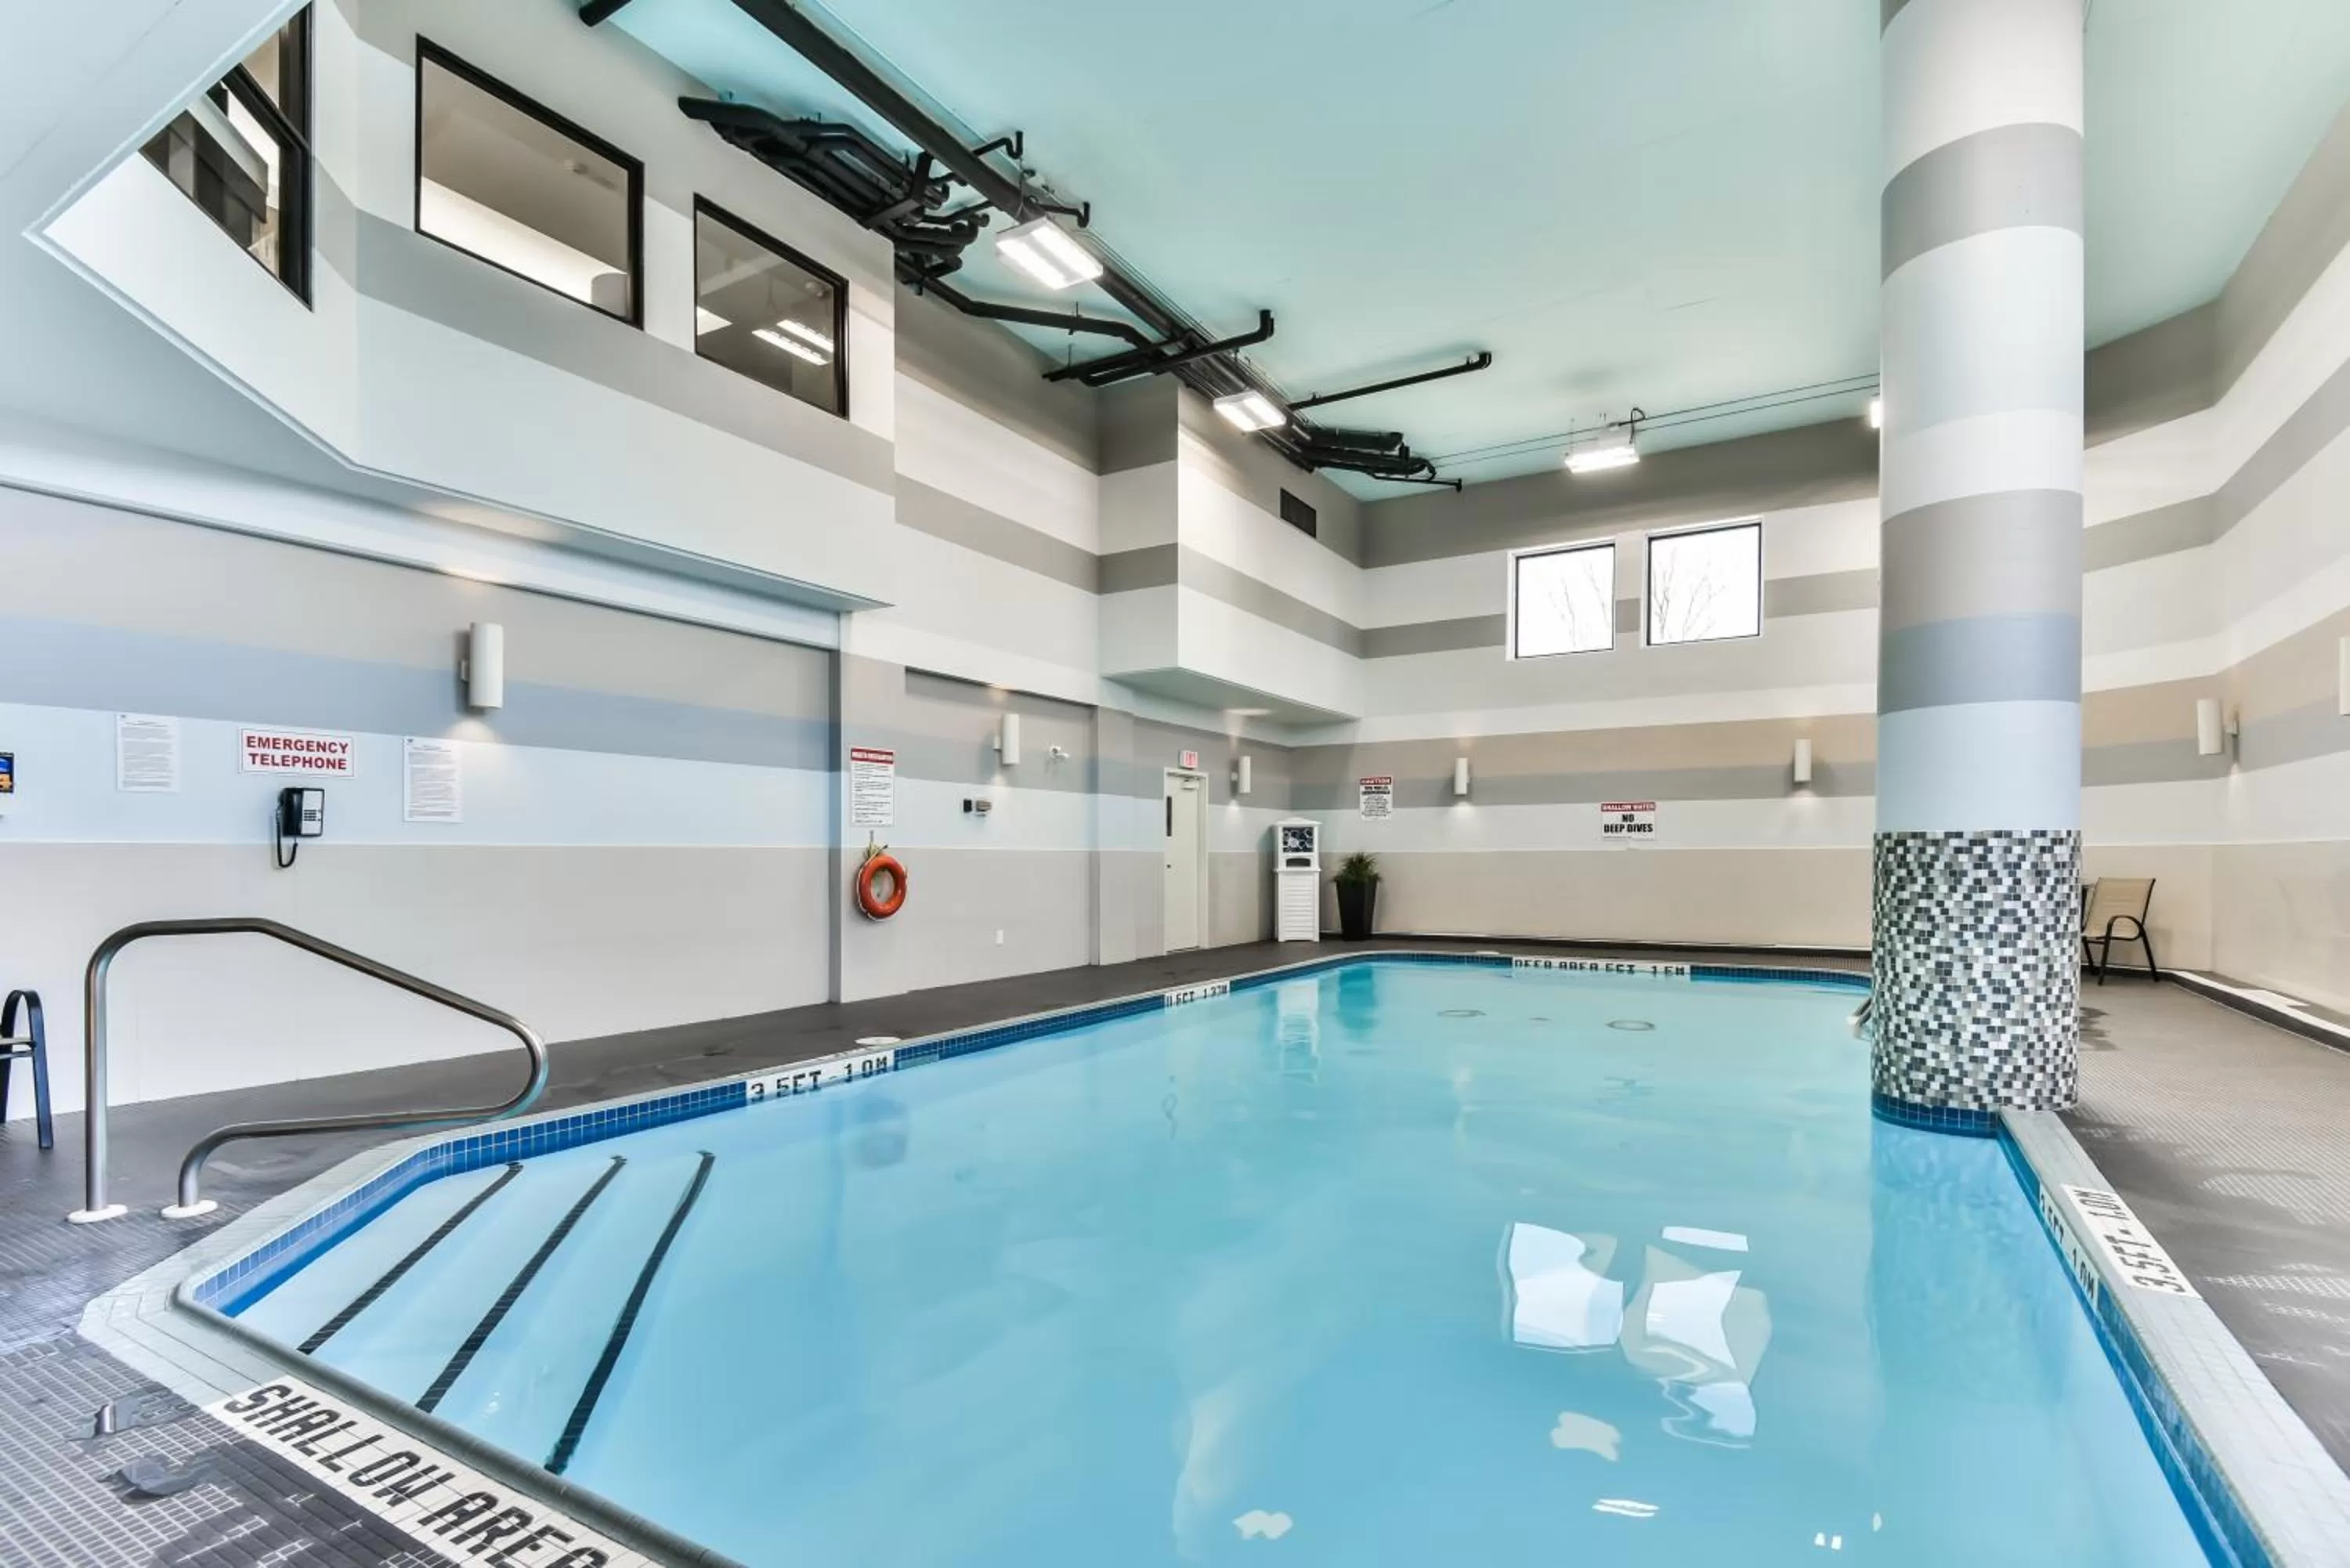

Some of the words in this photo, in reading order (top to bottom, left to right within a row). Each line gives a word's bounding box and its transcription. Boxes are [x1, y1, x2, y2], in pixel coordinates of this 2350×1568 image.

[246, 735, 349, 754] EMERGENCY
[248, 753, 348, 770] TELEPHONE
[1622, 814, 1635, 822] NO
[1603, 823, 1625, 833] DEEP
[1627, 823, 1653, 833] DIVES
[223, 1383, 457, 1508] SHALLOW
